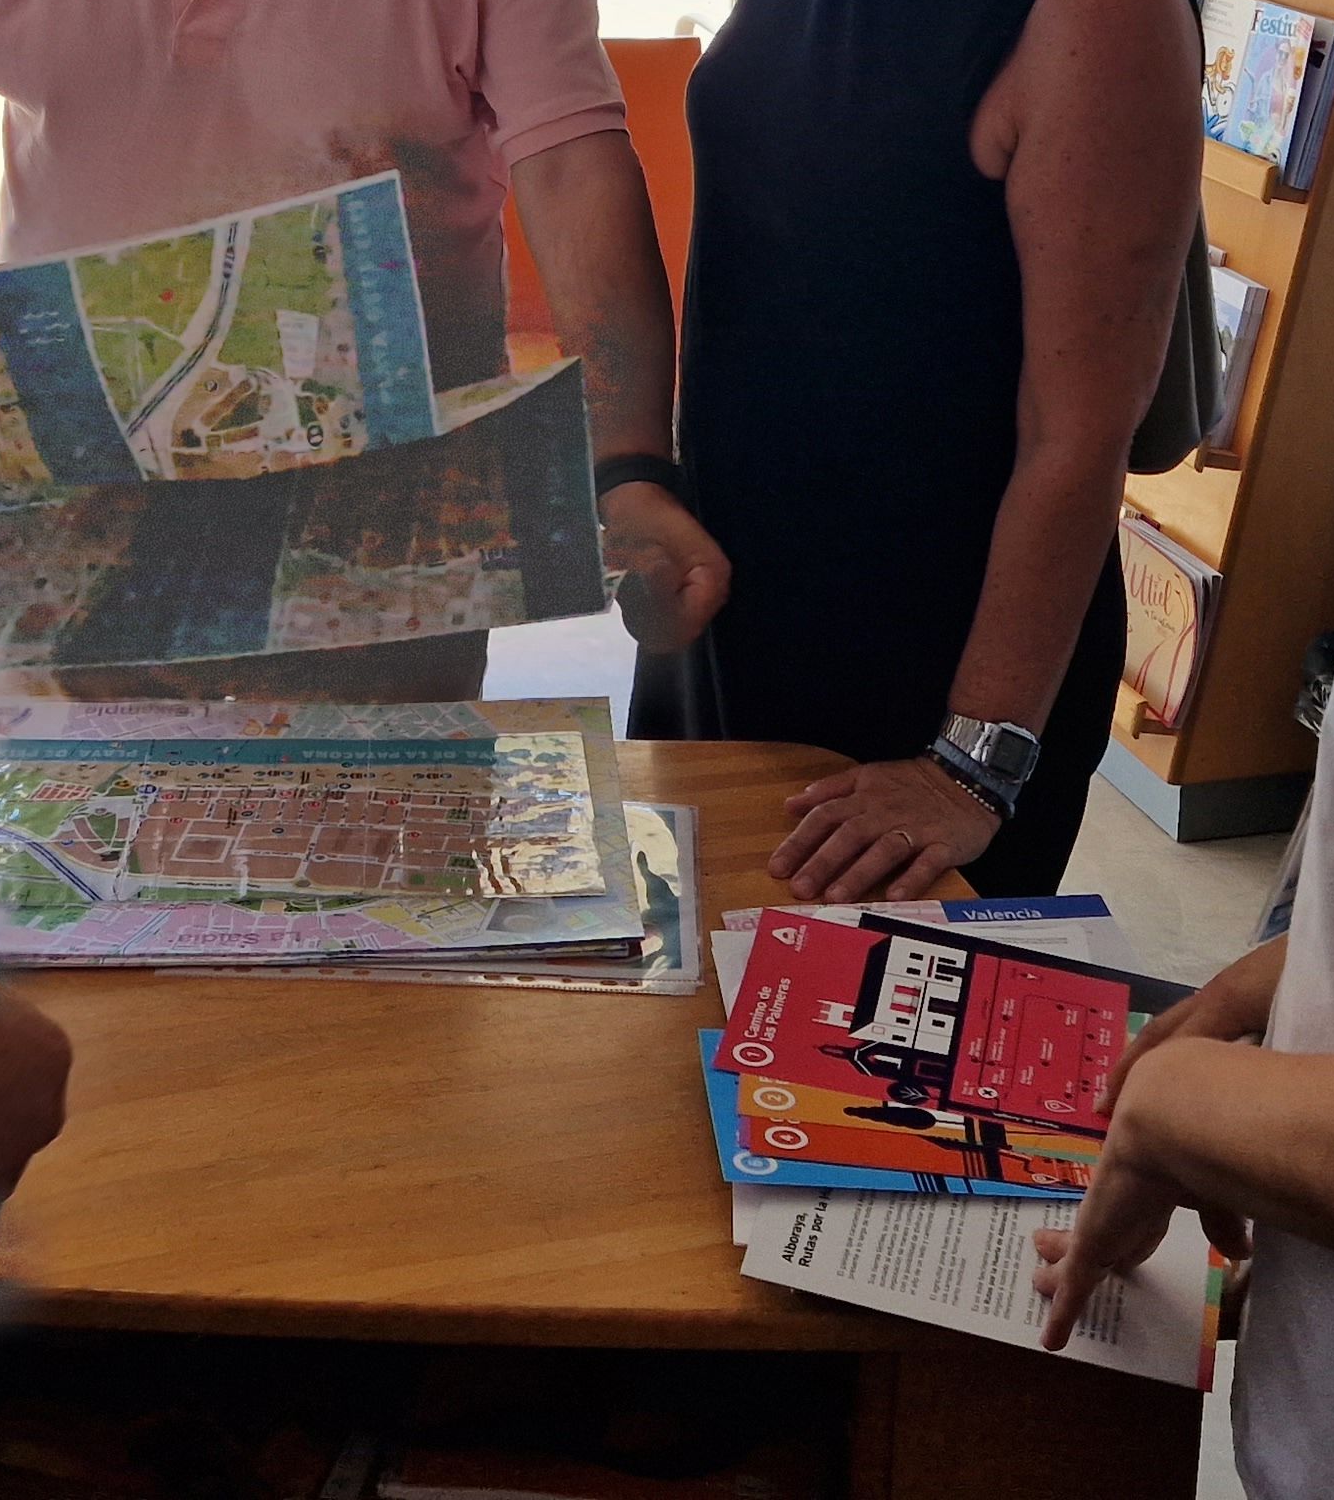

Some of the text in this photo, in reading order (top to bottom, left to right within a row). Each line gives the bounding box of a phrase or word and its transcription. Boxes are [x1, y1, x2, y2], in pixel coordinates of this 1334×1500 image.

[302, 750, 401, 759] PATACONA
[404, 751, 427, 759] LA
[962, 908, 1042, 920] Valencia
[744, 986, 772, 1038] Camino de
[760, 978, 791, 1041] las Palmeras
[782, 1212, 808, 1263] Alboraya,
[798, 1202, 827, 1267] Rutas por la
